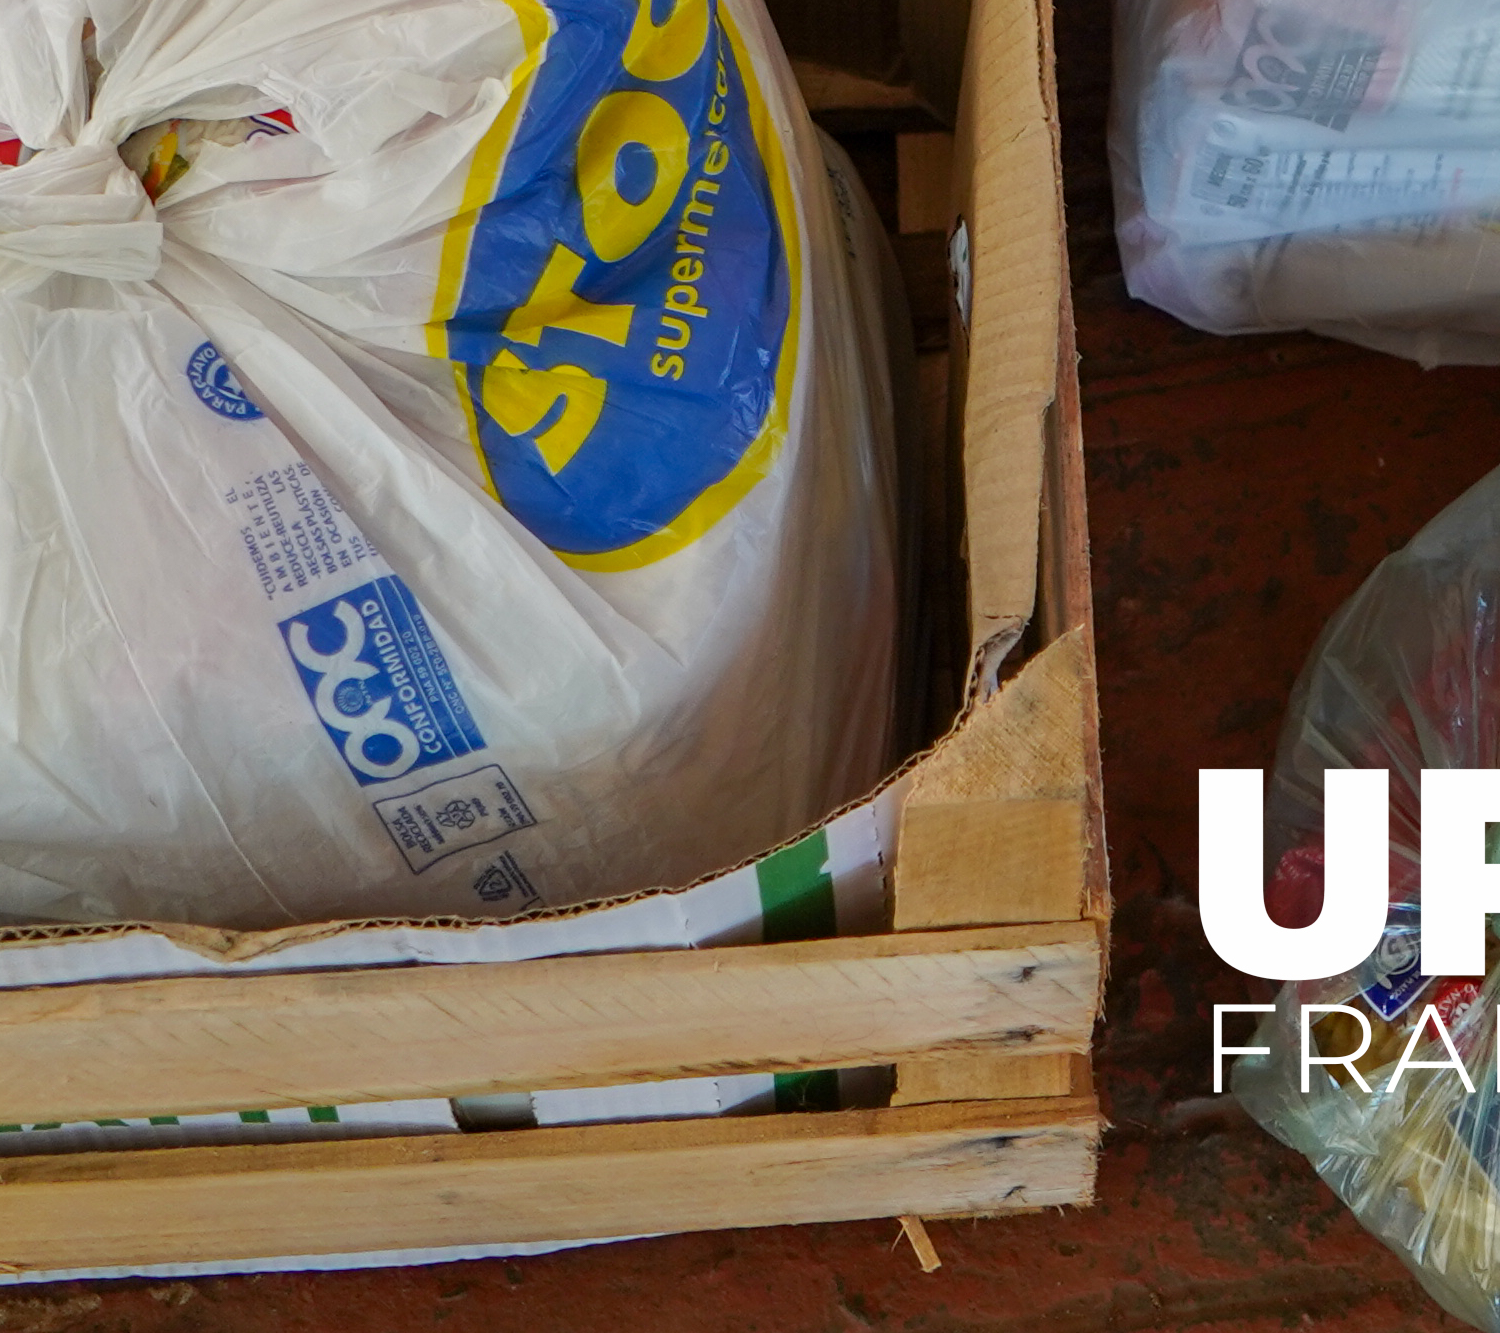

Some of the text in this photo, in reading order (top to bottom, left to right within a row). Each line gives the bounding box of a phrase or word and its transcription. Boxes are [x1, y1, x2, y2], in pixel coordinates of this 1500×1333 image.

[222, 487, 238, 503] EL
[266, 469, 285, 493] LAS
[306, 487, 343, 545] OCASIÓN
[310, 526, 340, 574] BOLSAS
[337, 547, 353, 567] EN
[347, 534, 368, 561] TUS
[358, 596, 444, 755] CONFORMIDAD
[393, 817, 417, 848] BOLSA
[397, 805, 434, 853] RECICLADA
